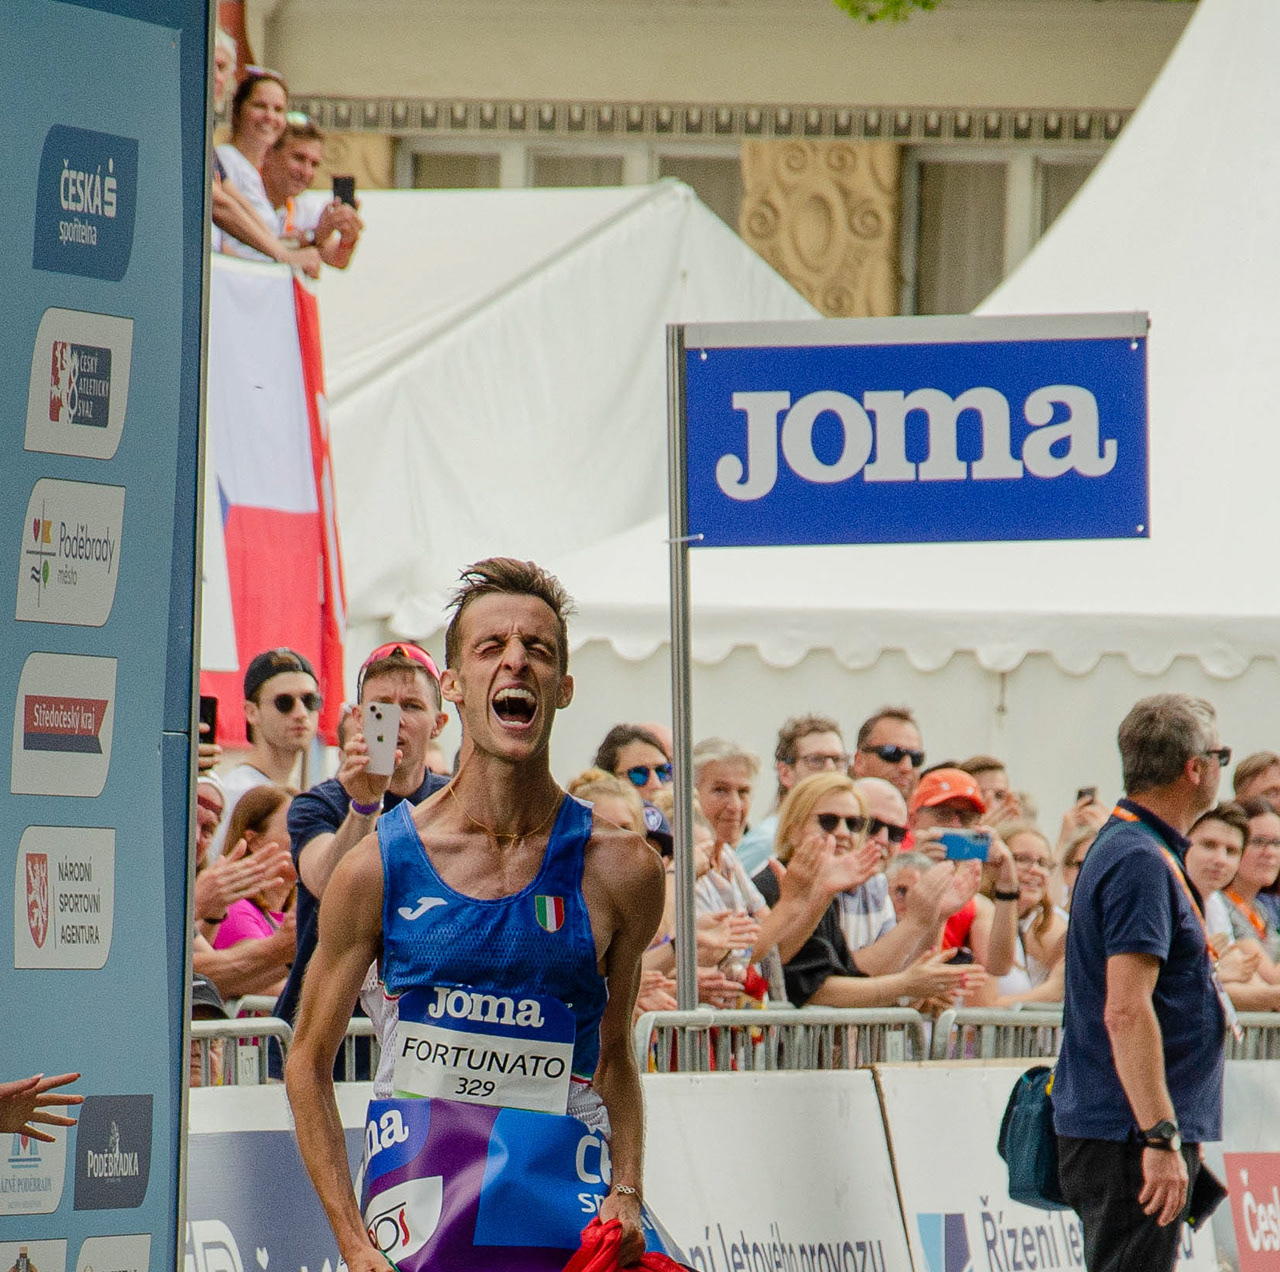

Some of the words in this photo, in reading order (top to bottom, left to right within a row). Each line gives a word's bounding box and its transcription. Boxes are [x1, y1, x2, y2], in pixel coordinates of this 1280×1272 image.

[60, 157, 102, 216] ČESKÁ
[58, 217, 98, 246] spořitelna
[58, 520, 116, 575] Poděbrady
[58, 854, 93, 882] NÁRODNÍ
[59, 886, 101, 914] SPORTOVNÍ
[60, 924, 100, 945] AGENTURA
[401, 1036, 567, 1079] FORTUNATO
[454, 1076, 496, 1098] 329
